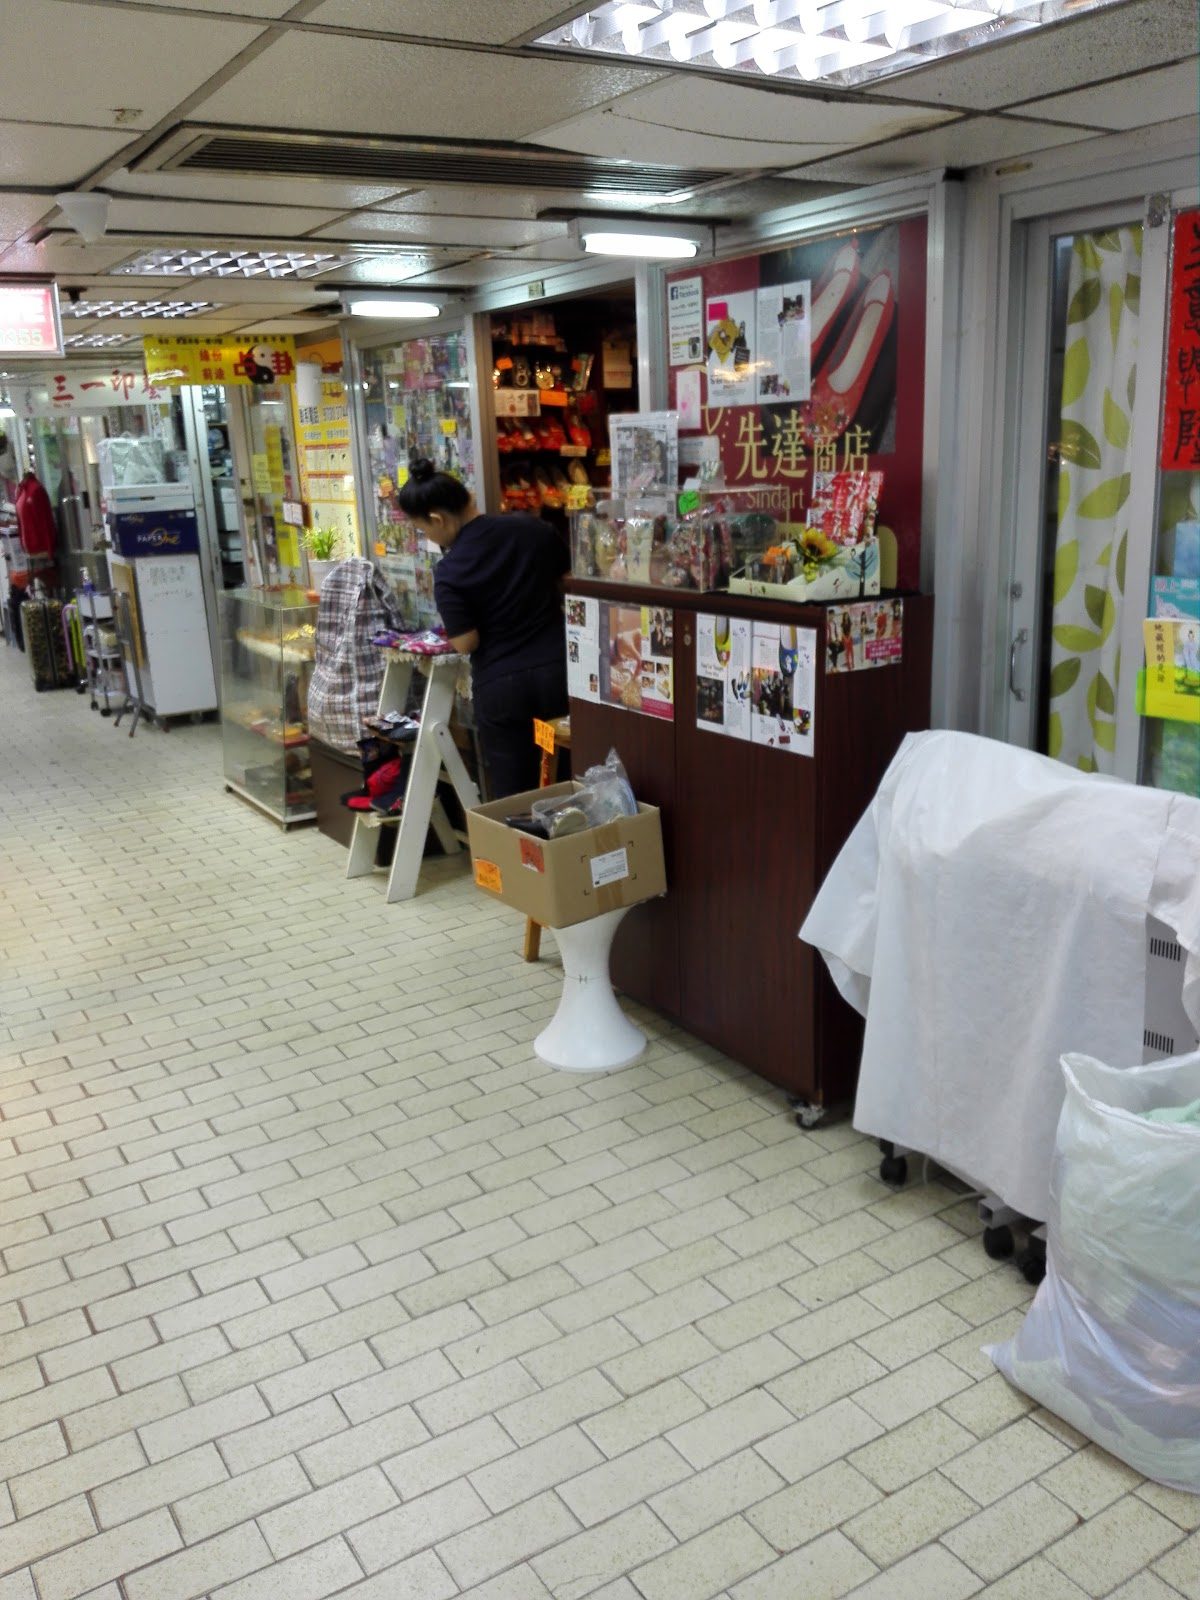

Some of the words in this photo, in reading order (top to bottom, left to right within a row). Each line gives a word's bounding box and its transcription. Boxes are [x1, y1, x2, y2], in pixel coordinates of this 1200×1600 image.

[735, 408, 872, 480] 先達商店
[746, 487, 804, 509] Sindart
